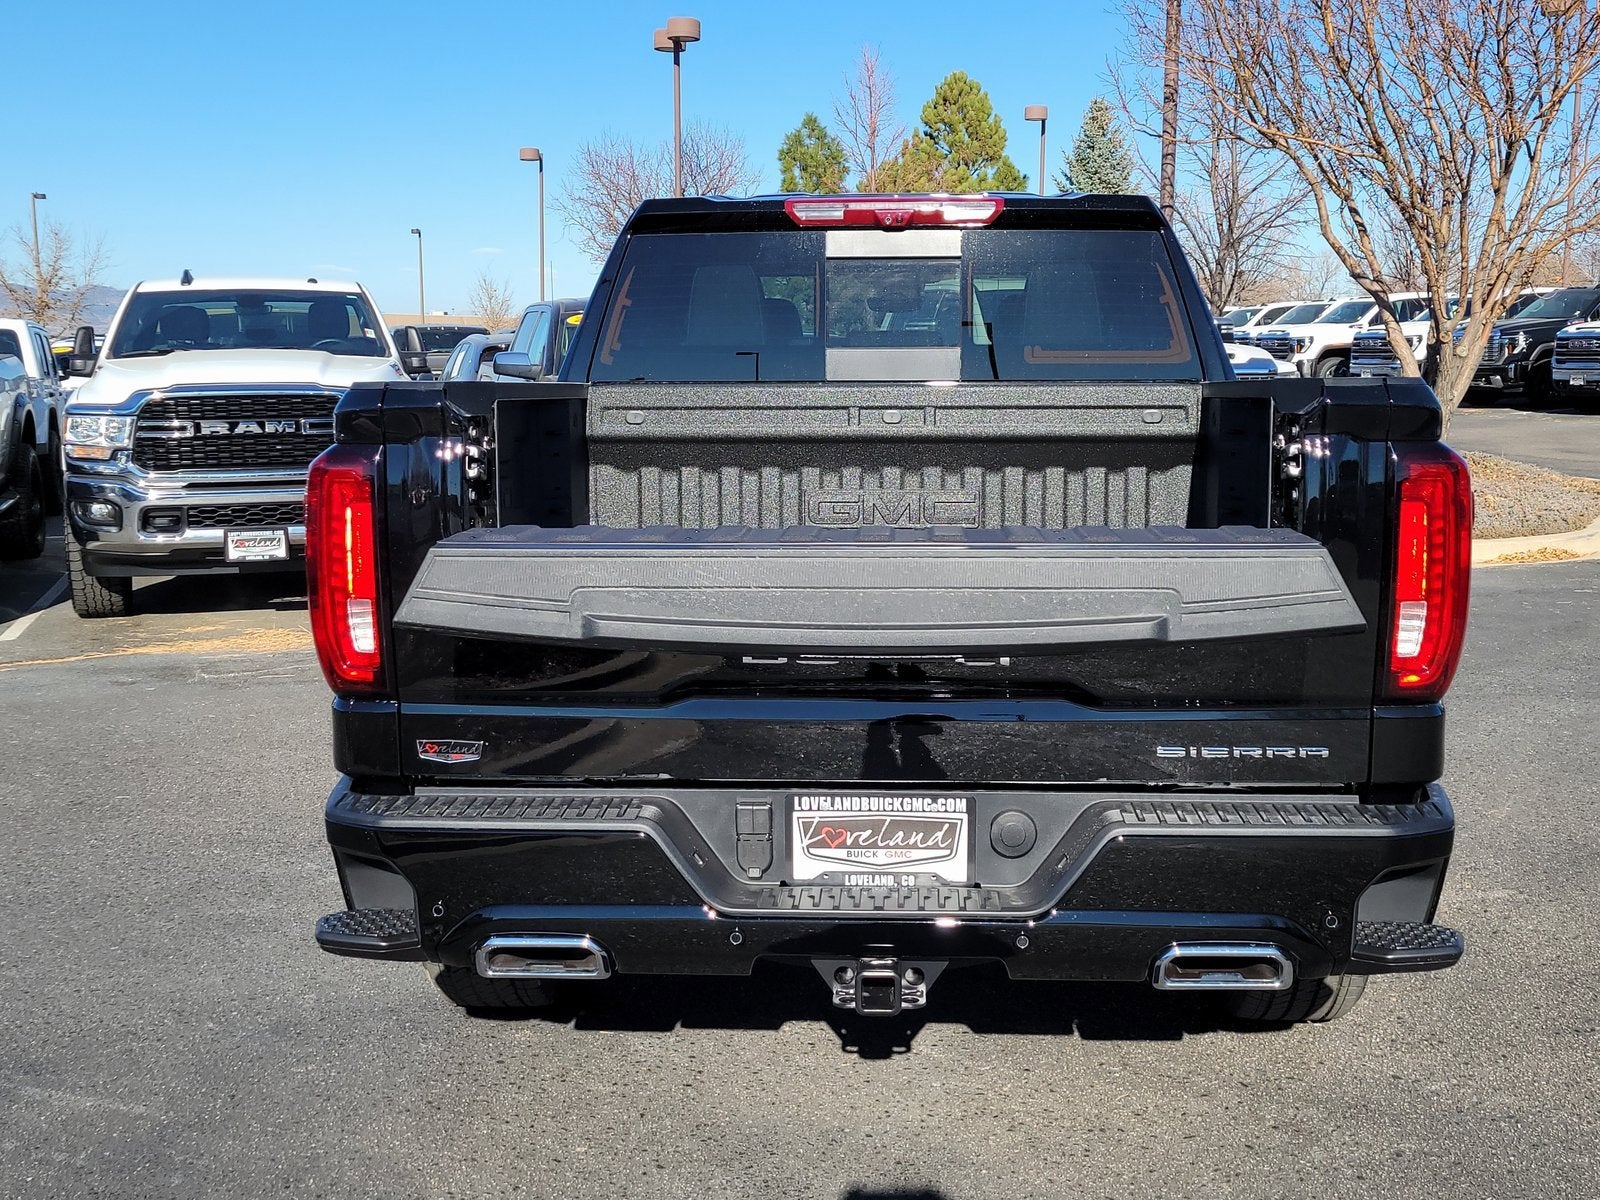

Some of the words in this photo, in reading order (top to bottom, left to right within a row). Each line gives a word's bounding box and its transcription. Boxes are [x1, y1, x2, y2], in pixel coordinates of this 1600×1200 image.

[200, 420, 296, 435] RAM
[807, 491, 979, 526] GMC
[1156, 746, 1330, 759] SIERRA
[793, 796, 967, 812] LOVELANDBUICKGMC.COM
[846, 850, 879, 859] BUICK
[884, 850, 913, 859] GMC
[844, 875, 898, 887] LOVELAND,
[901, 875, 915, 887] CO
